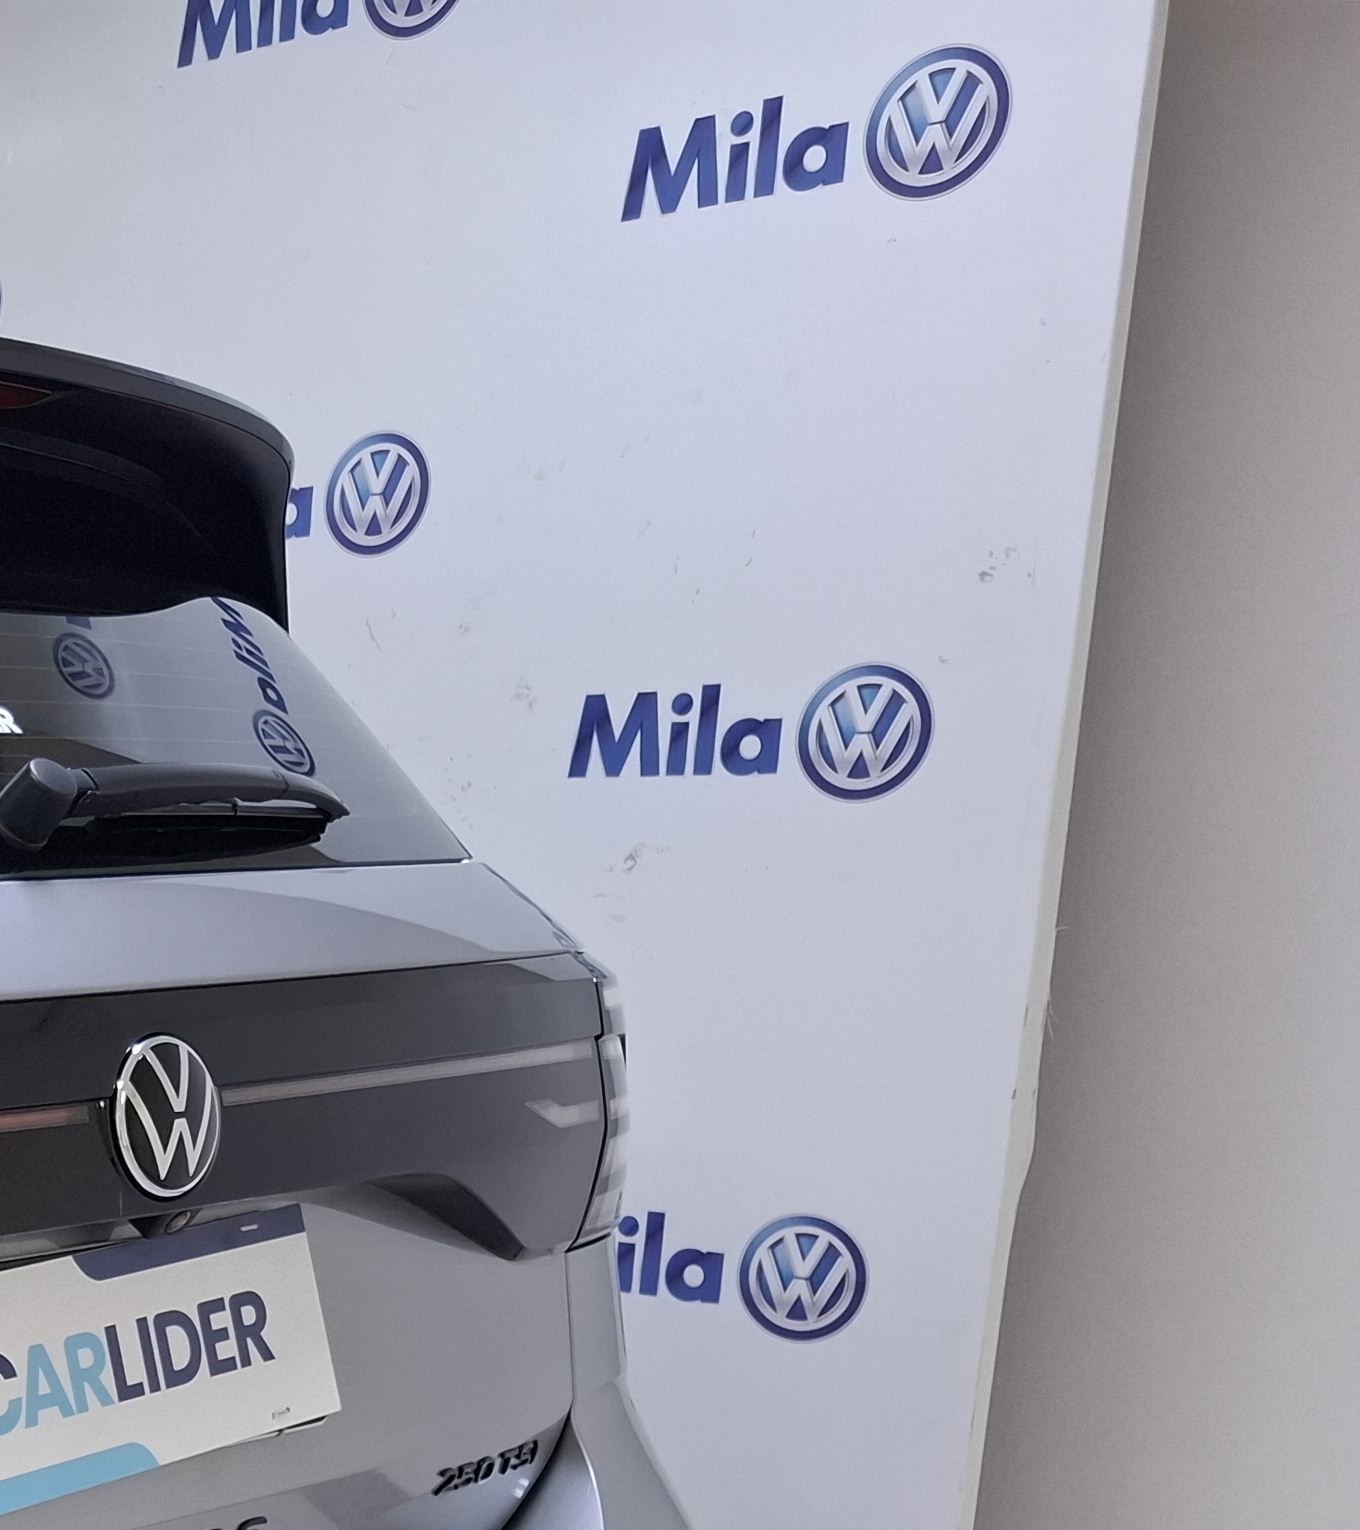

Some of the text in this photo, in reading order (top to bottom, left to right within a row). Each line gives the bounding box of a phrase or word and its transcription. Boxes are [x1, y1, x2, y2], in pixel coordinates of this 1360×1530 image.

[621, 96, 849, 222] Mila
[568, 684, 782, 778] Mila
[119, 1043, 215, 1192] VW
[616, 1212, 724, 1303] ila
[432, 1456, 494, 1496] 250
